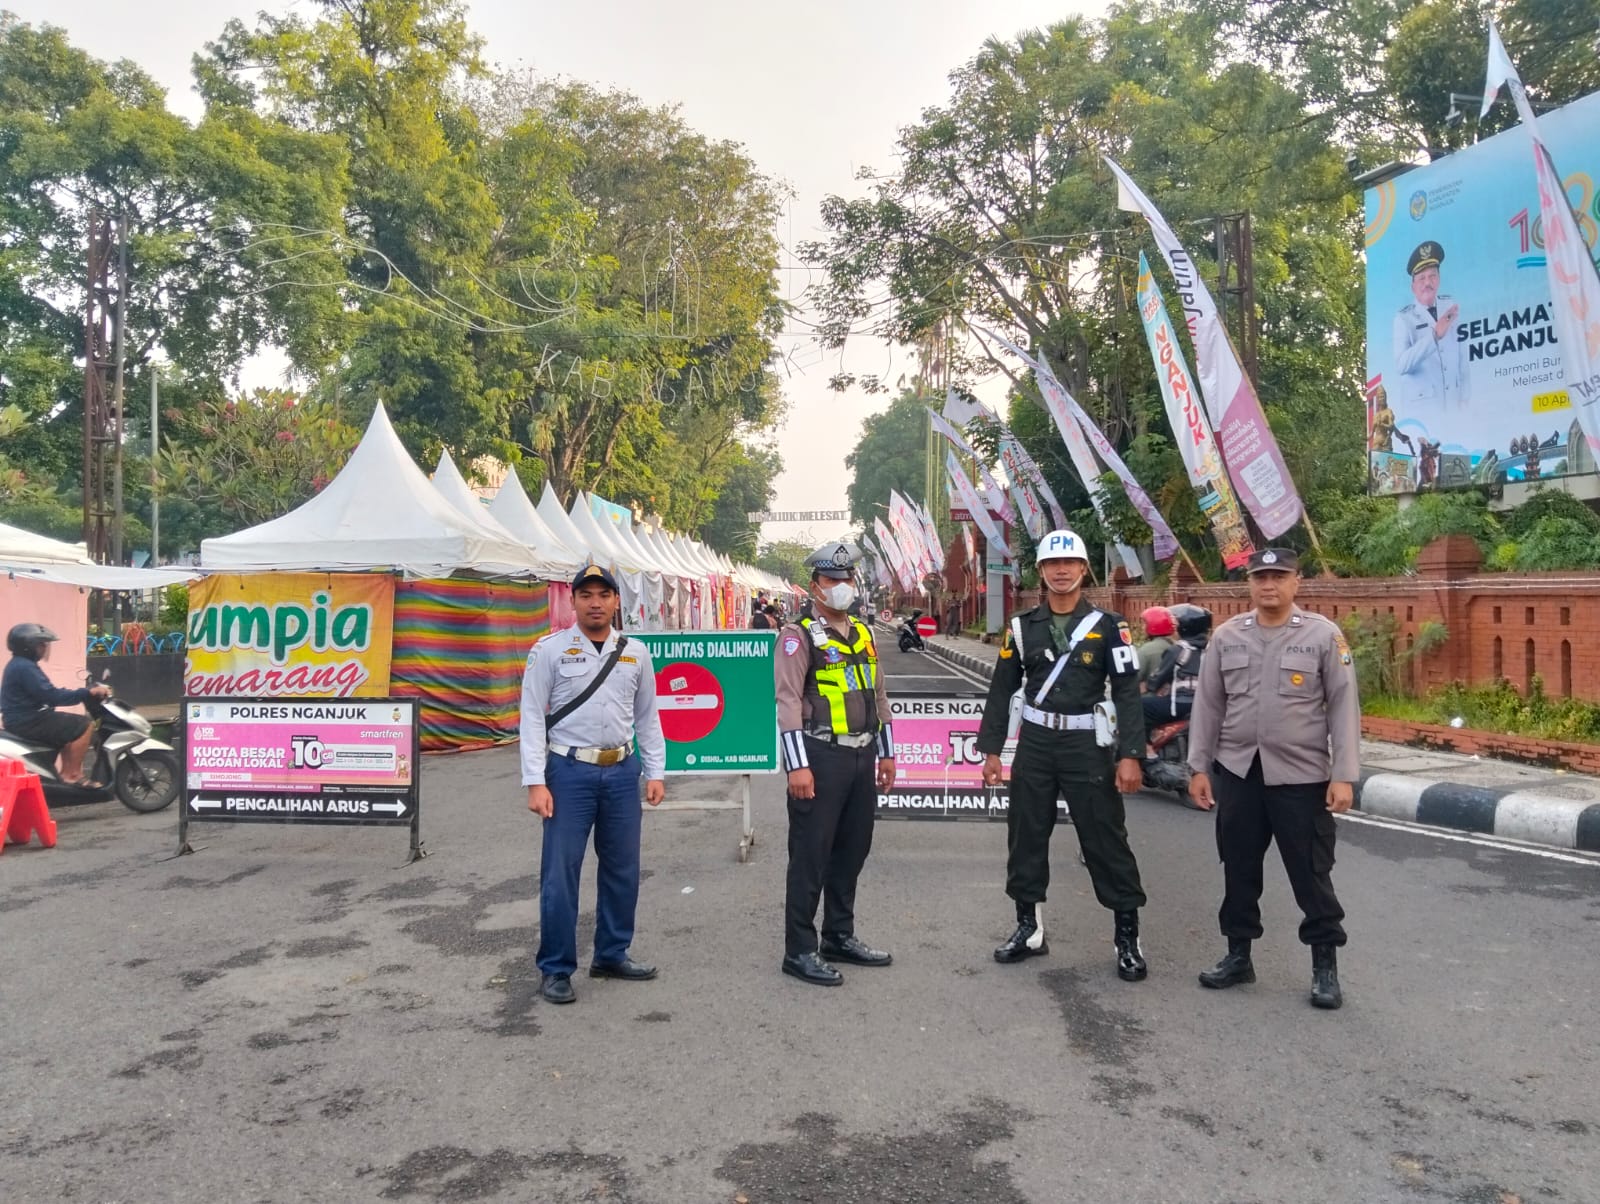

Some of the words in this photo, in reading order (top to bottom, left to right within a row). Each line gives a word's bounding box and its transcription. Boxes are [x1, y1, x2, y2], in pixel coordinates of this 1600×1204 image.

[1457, 301, 1552, 342] SELAMA
[1469, 325, 1558, 361] NGANJU
[1494, 359, 1539, 377] Harmoni
[1513, 370, 1552, 387] Melesat
[1556, 368, 1564, 380] d
[1155, 323, 1205, 447] NGANJUK
[1537, 396, 1549, 407] 10
[800, 510, 847, 520] MELESAT
[1050, 536, 1074, 551] PM
[188, 594, 369, 661] umpia
[647, 642, 661, 658] LU
[664, 641, 704, 658] LINTAS
[707, 641, 769, 657] DIALIHKAN
[1286, 646, 1315, 654] POLRI
[230, 706, 288, 718] POLRES
[292, 707, 367, 719] NGANJUK
[890, 702, 944, 714] OLRES
[948, 703, 985, 714] NGA
[360, 730, 404, 739] smartfren
[193, 746, 238, 758] KUOTA
[240, 747, 286, 759] BESAR
[291, 740, 325, 767] 10
[893, 743, 943, 755] BESAR
[193, 758, 242, 767] JAGOAN
[243, 759, 284, 768] LOKAL
[724, 755, 738, 763] KAB
[738, 754, 769, 763] NGANJUK
[896, 754, 942, 764] LOKAL
[226, 797, 323, 811] PENGALIHAN
[326, 800, 370, 813] ARUS
[877, 794, 985, 809] PENGALIHAN
[988, 796, 1010, 809] AR
